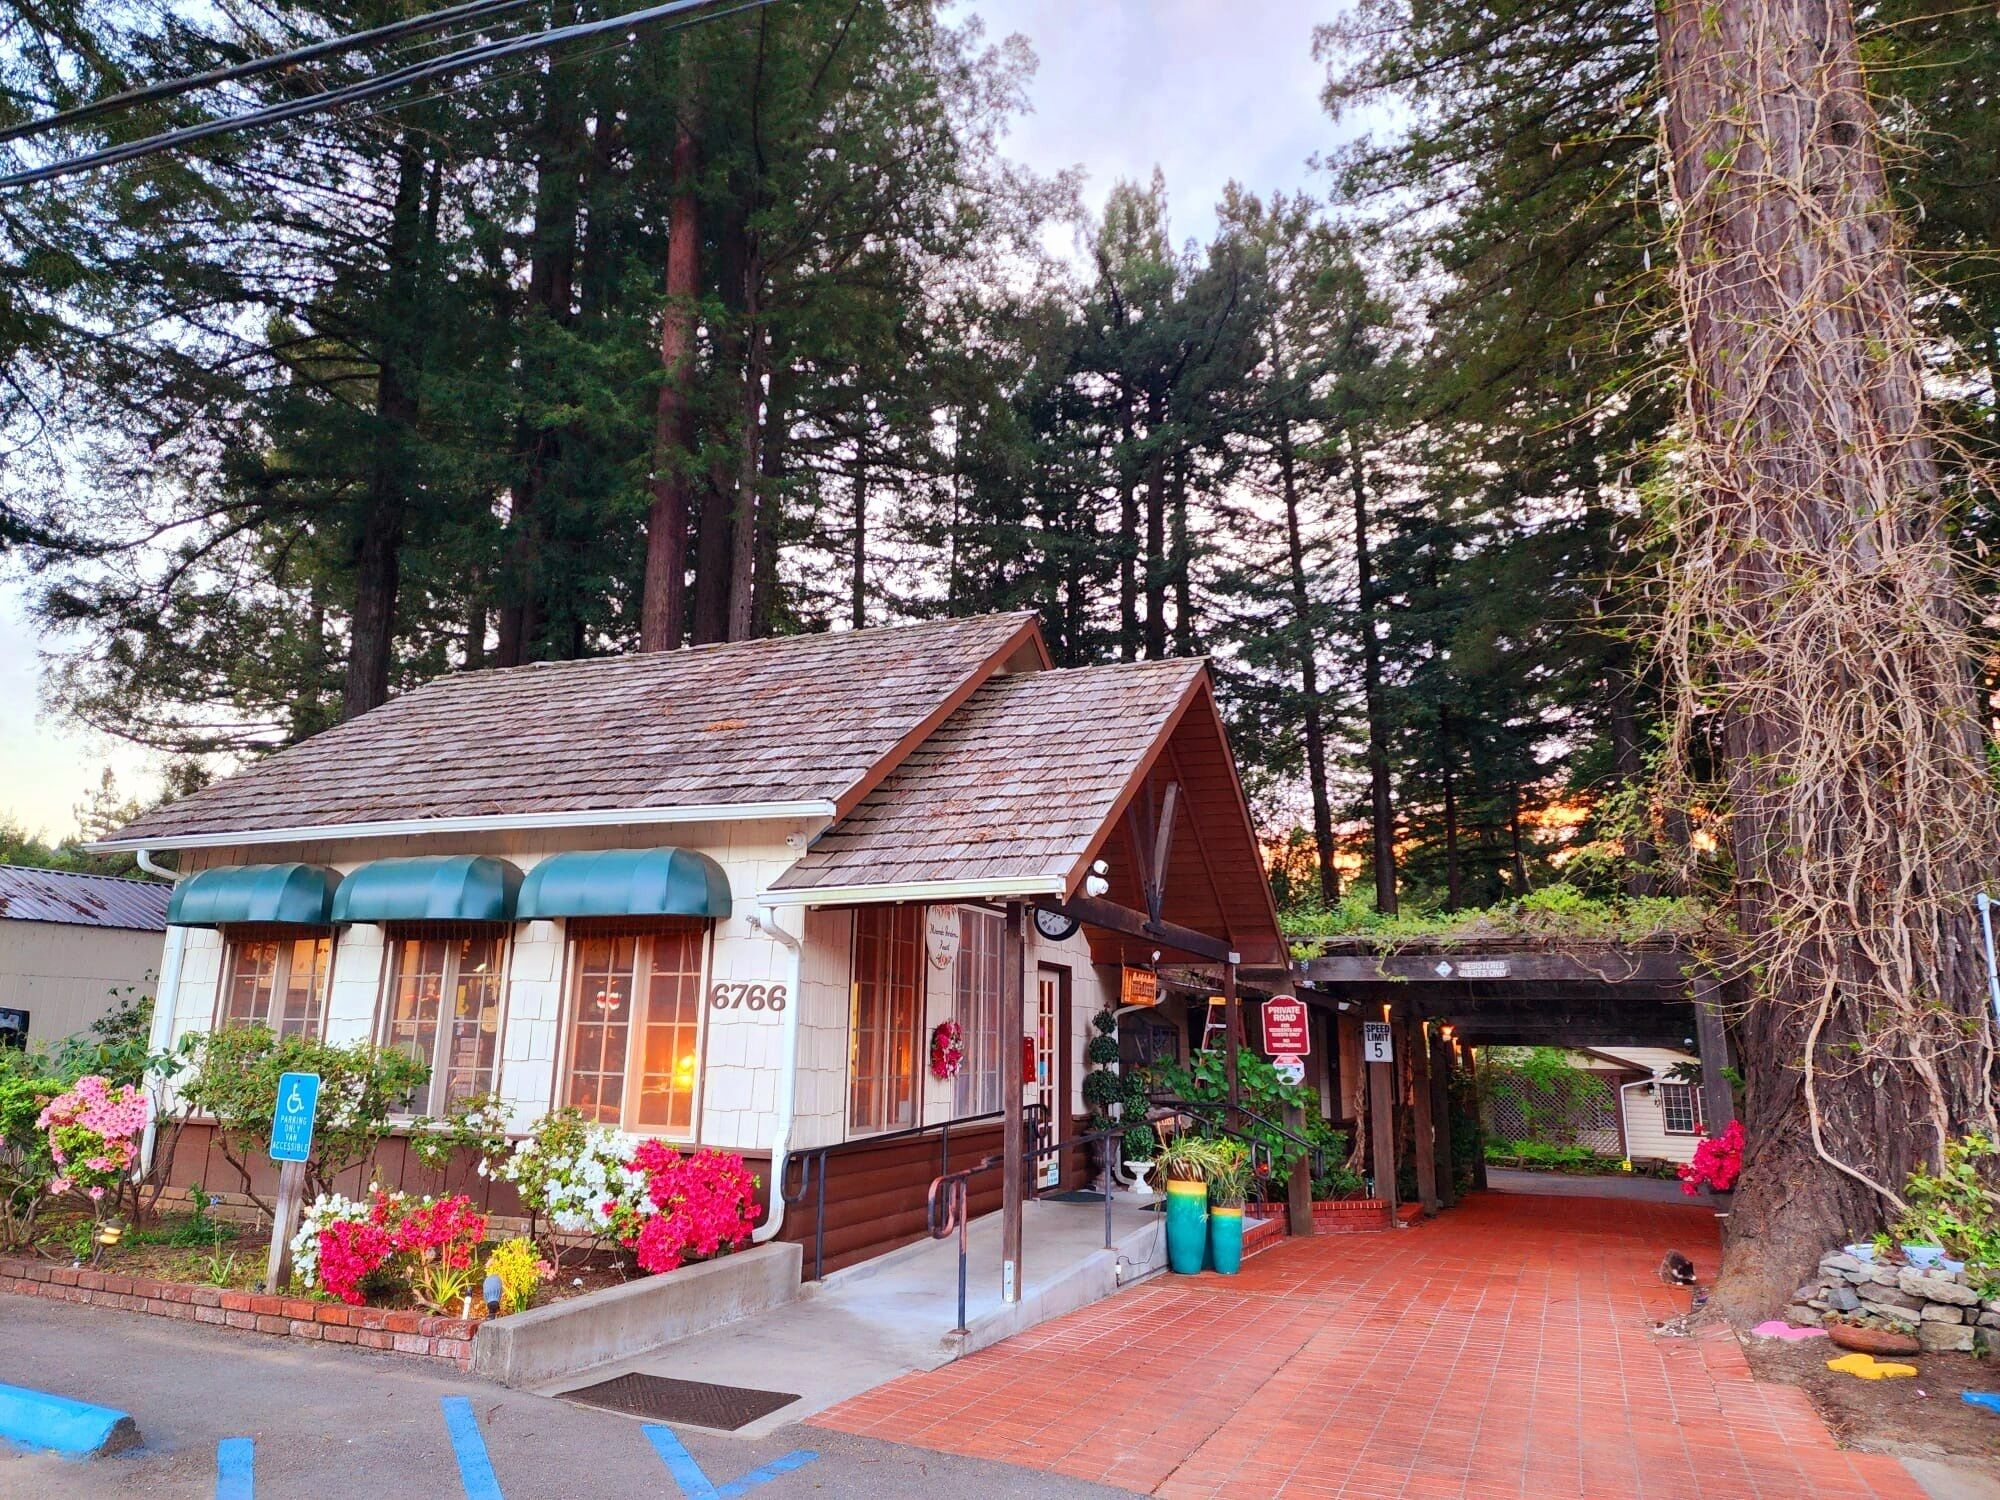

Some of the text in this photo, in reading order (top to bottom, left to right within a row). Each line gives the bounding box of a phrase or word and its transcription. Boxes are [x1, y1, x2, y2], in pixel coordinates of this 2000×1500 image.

[1459, 961, 1505, 969] REGISTERED
[1459, 968, 1507, 977] GUESTS ONLY
[711, 983, 787, 1012] 6766
[1268, 1006, 1301, 1014] PRIVATE
[1273, 1014, 1297, 1022] ROAD
[1365, 1024, 1390, 1033] SPEED
[1367, 1033, 1389, 1042] LIMIT
[1374, 1042, 1384, 1058] 5
[280, 1115, 307, 1125] PARKING
[284, 1123, 301, 1133] ONLY
[285, 1133, 298, 1142] VAN
[272, 1141, 309, 1153] ACCESSIBLE
